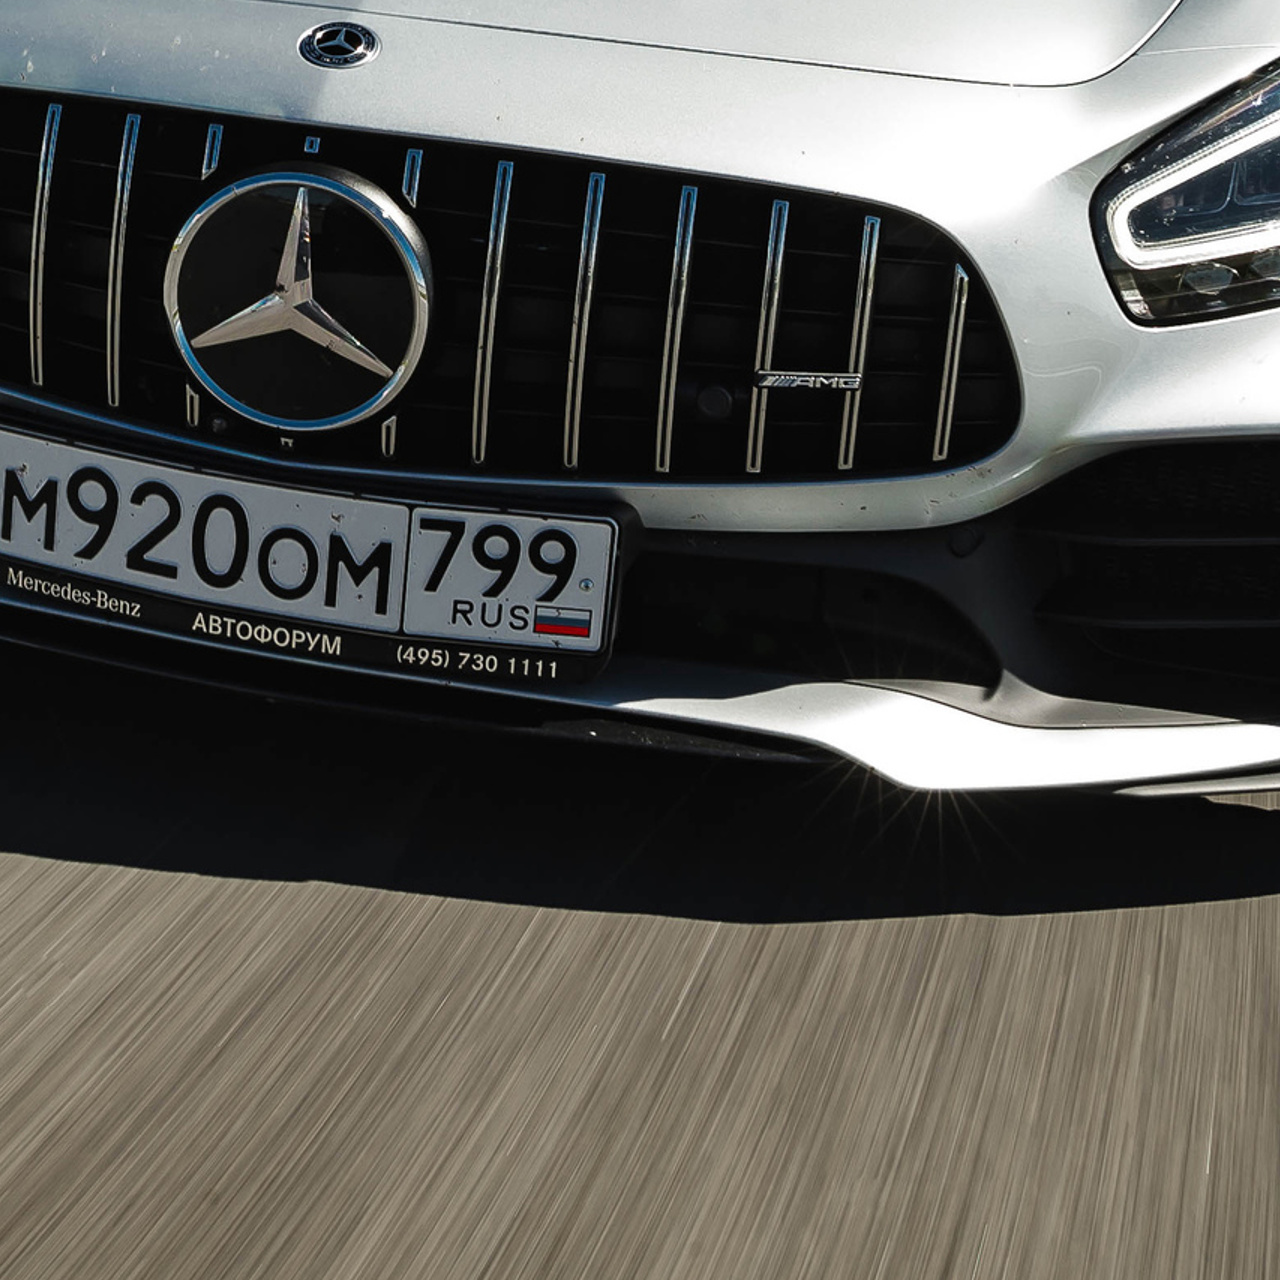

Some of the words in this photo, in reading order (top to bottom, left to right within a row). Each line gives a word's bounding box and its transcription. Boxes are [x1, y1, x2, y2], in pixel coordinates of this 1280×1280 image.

[792, 376, 862, 388] AMG
[418, 519, 578, 603] 799
[6, 567, 142, 618] Mercedes-Benz
[191, 612, 342, 656] АВТОФОРУМ
[450, 599, 531, 632] RUS
[396, 644, 450, 669] (495)
[457, 651, 499, 673] 730
[507, 657, 559, 679] 1111
